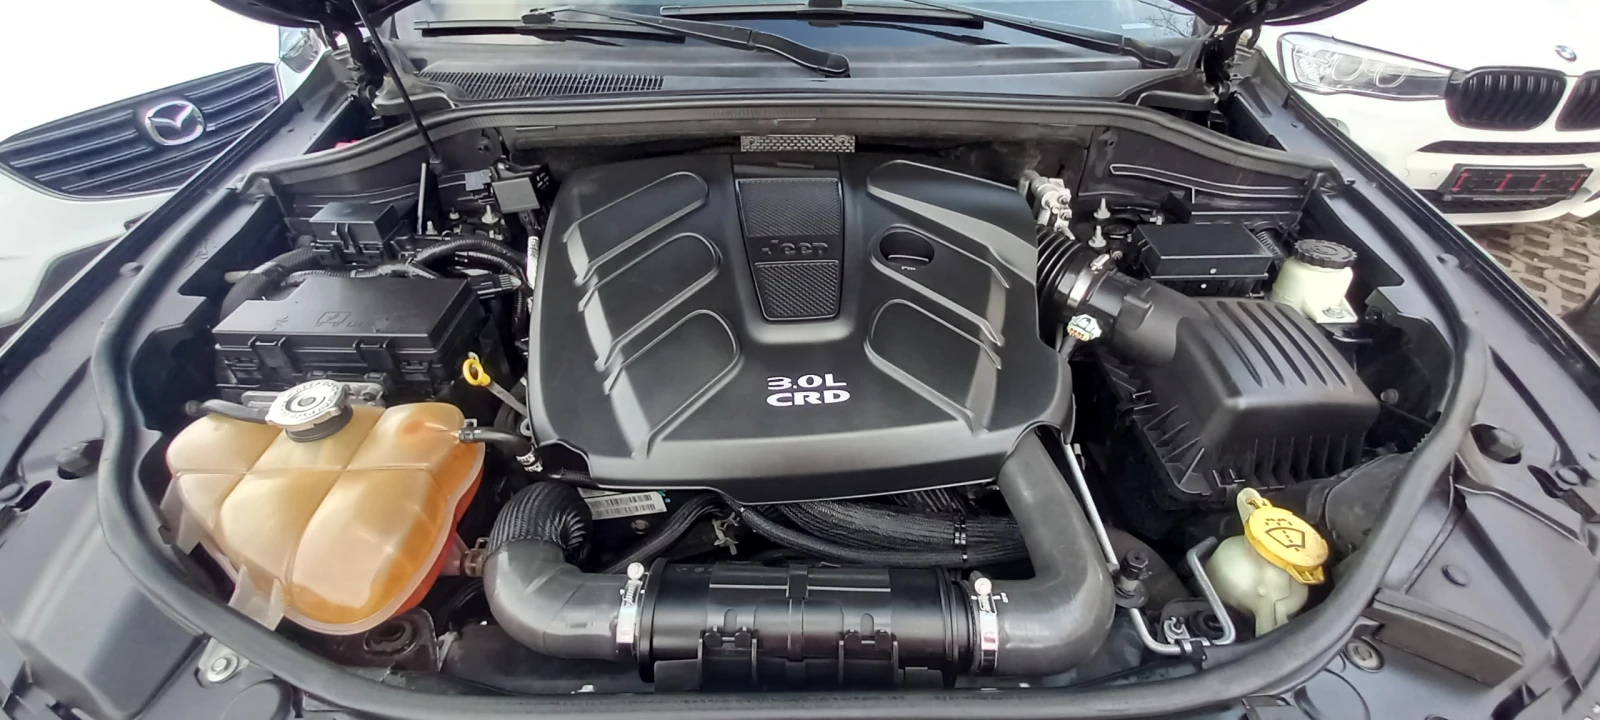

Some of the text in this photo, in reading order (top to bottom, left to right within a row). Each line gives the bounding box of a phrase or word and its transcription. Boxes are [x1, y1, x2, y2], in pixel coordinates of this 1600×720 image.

[761, 239, 829, 256] Jeep
[767, 373, 847, 390] 3.0L
[766, 389, 851, 407] CRD
